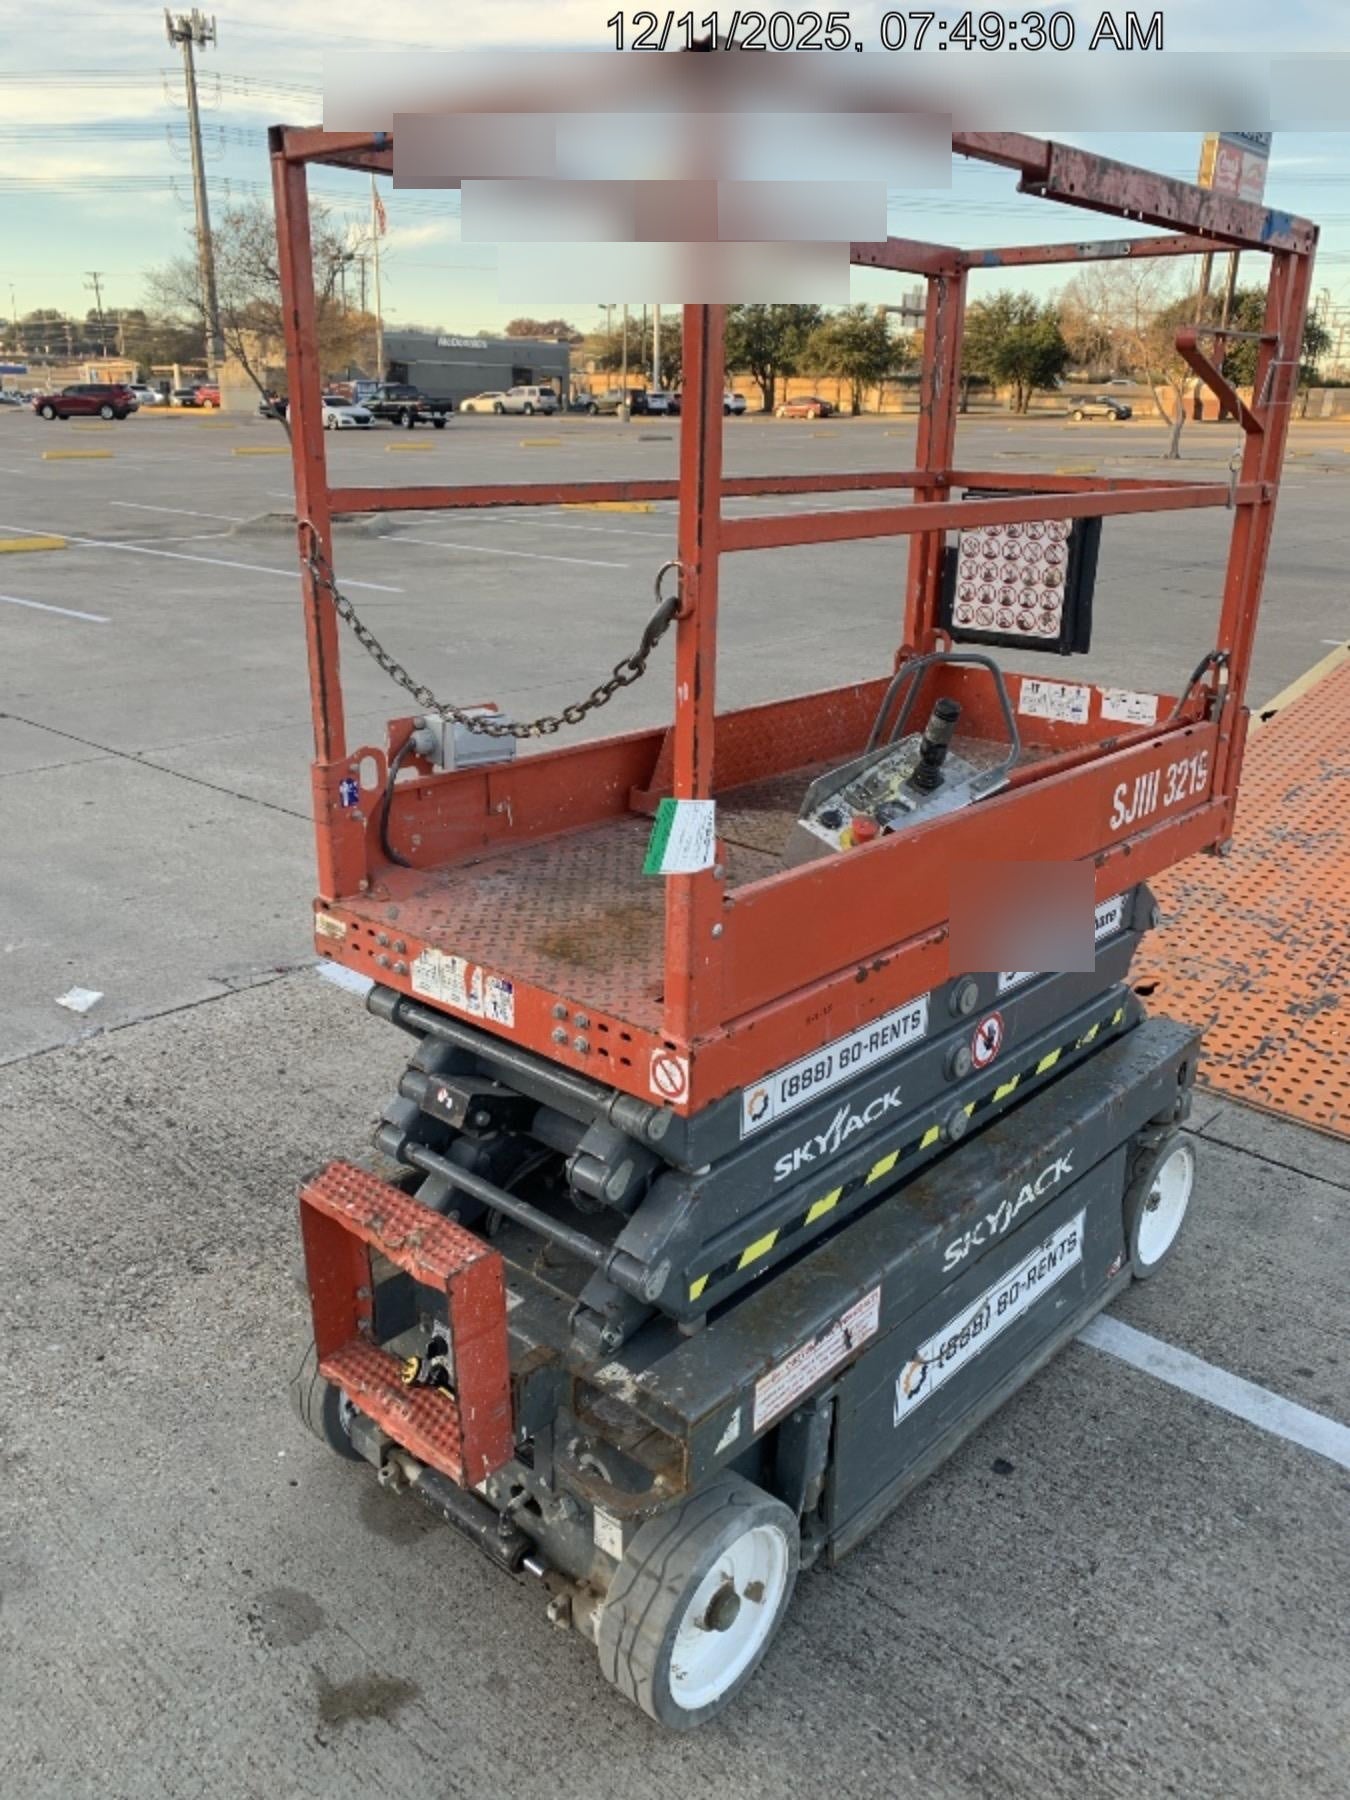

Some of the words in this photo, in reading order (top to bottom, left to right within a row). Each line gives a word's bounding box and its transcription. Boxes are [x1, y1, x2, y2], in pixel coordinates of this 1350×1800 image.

[781, 1056, 833, 1102] (888)
[839, 1010, 921, 1069] 80-RENTS
[773, 1085, 903, 1182] SKYJACK
[942, 1147, 1075, 1272] SKYJACK
[939, 1301, 992, 1368] (888)
[997, 1231, 1078, 1316] 80-RENTS
